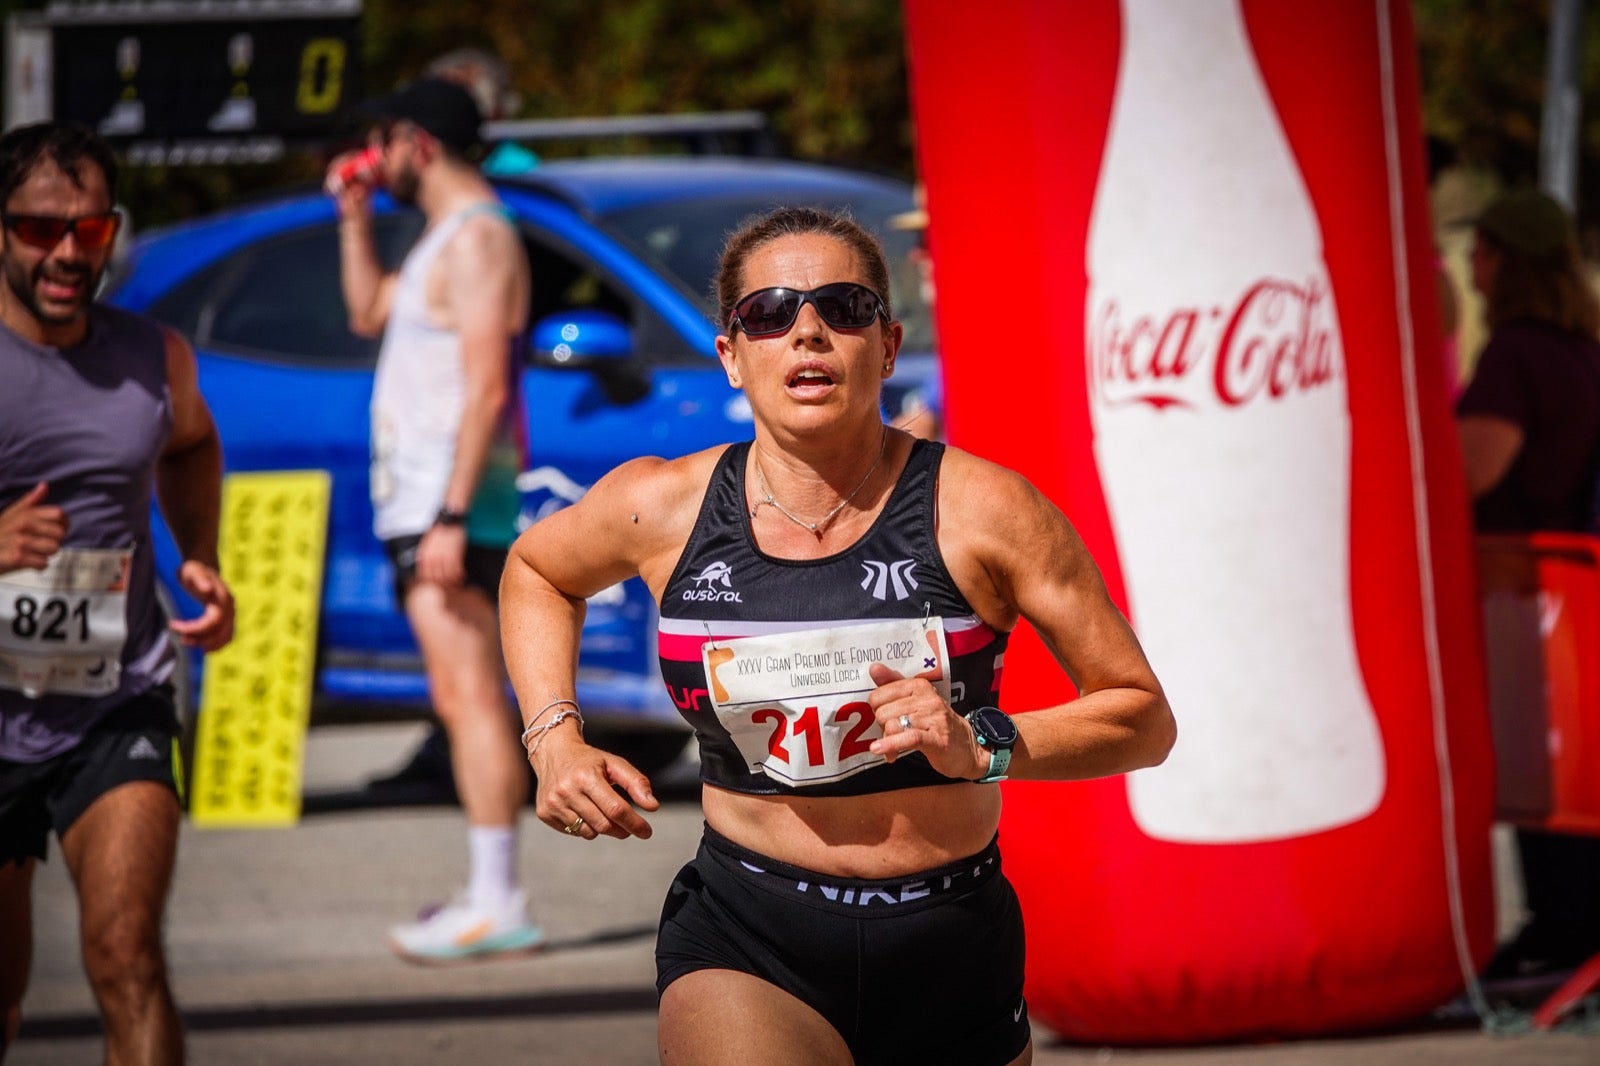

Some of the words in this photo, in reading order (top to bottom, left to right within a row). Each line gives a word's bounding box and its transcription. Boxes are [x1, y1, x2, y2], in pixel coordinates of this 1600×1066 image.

[682, 589, 744, 603] austral
[12, 596, 91, 643] 821
[736, 657, 762, 676] XXXV
[886, 640, 914, 660] 2022
[751, 700, 877, 767] 212
